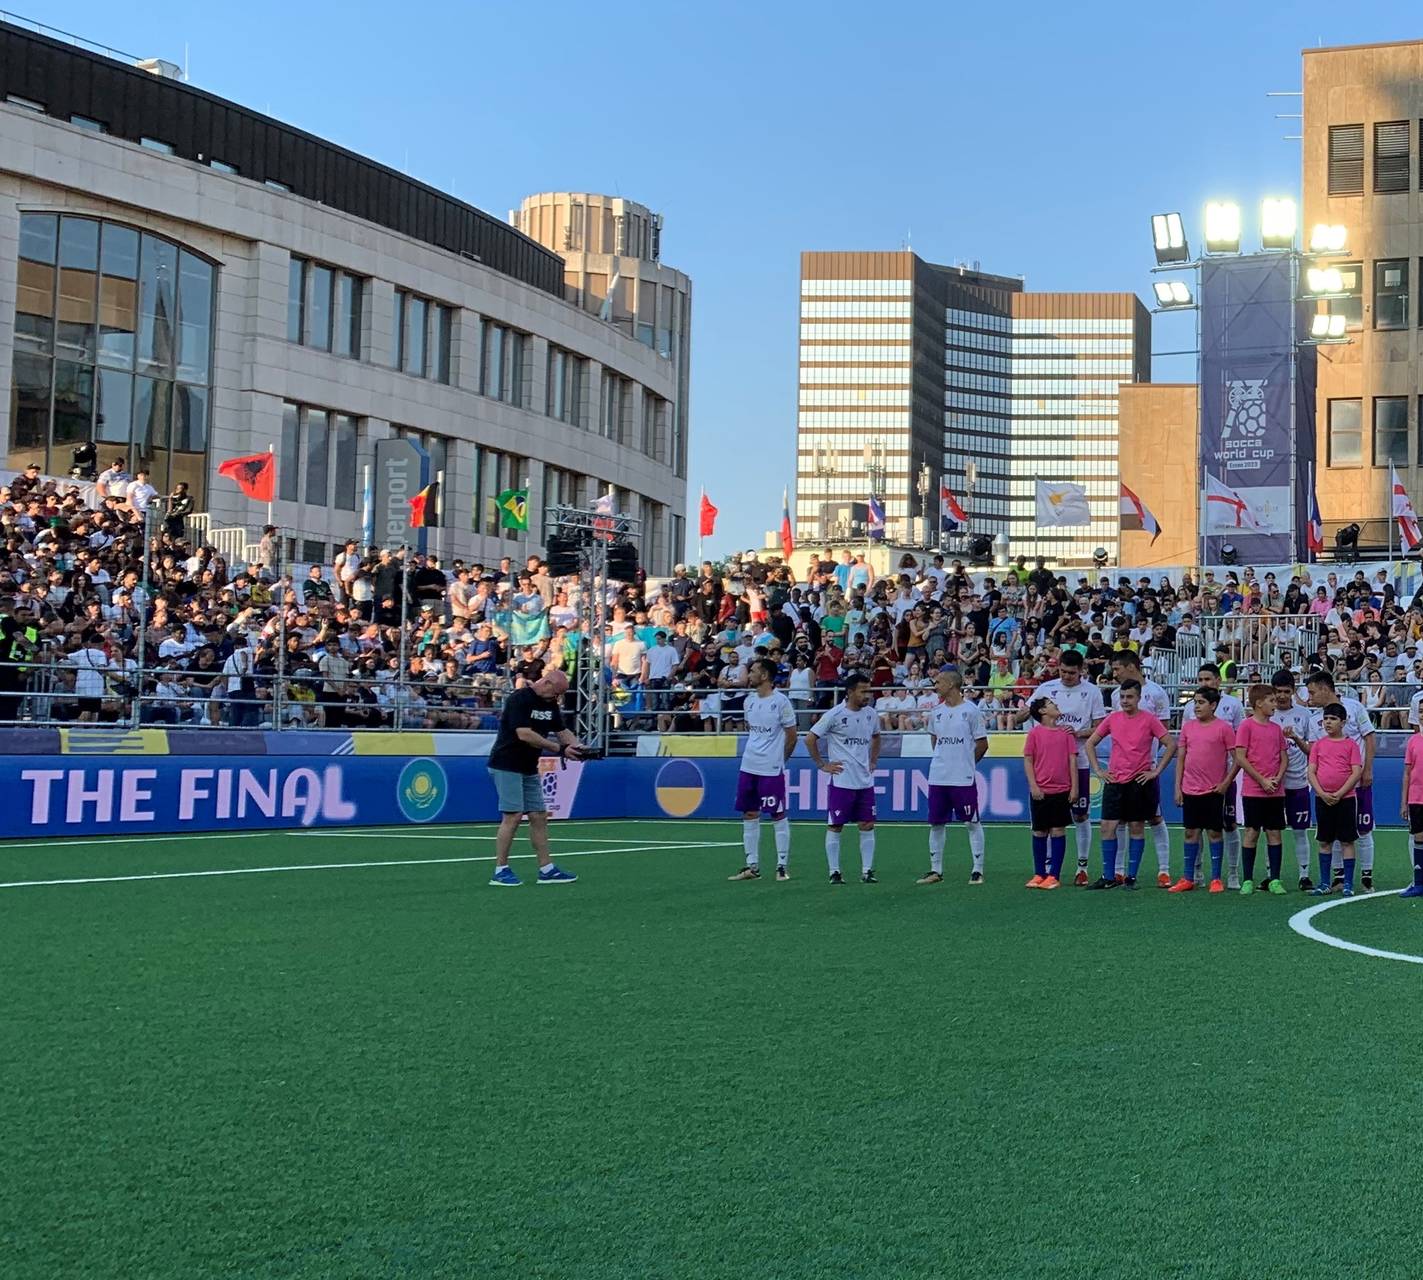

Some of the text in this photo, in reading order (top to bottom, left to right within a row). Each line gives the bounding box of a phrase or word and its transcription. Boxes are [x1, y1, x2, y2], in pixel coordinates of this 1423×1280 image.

[1225, 439, 1263, 448] socca
[1214, 448, 1274, 460] world cup
[1057, 712, 1082, 724] RIUM
[21, 762, 357, 827] THE FINAL
[761, 796, 776, 807] 70
[1295, 811, 1309, 823] 77
[1358, 813, 1371, 825] 10
